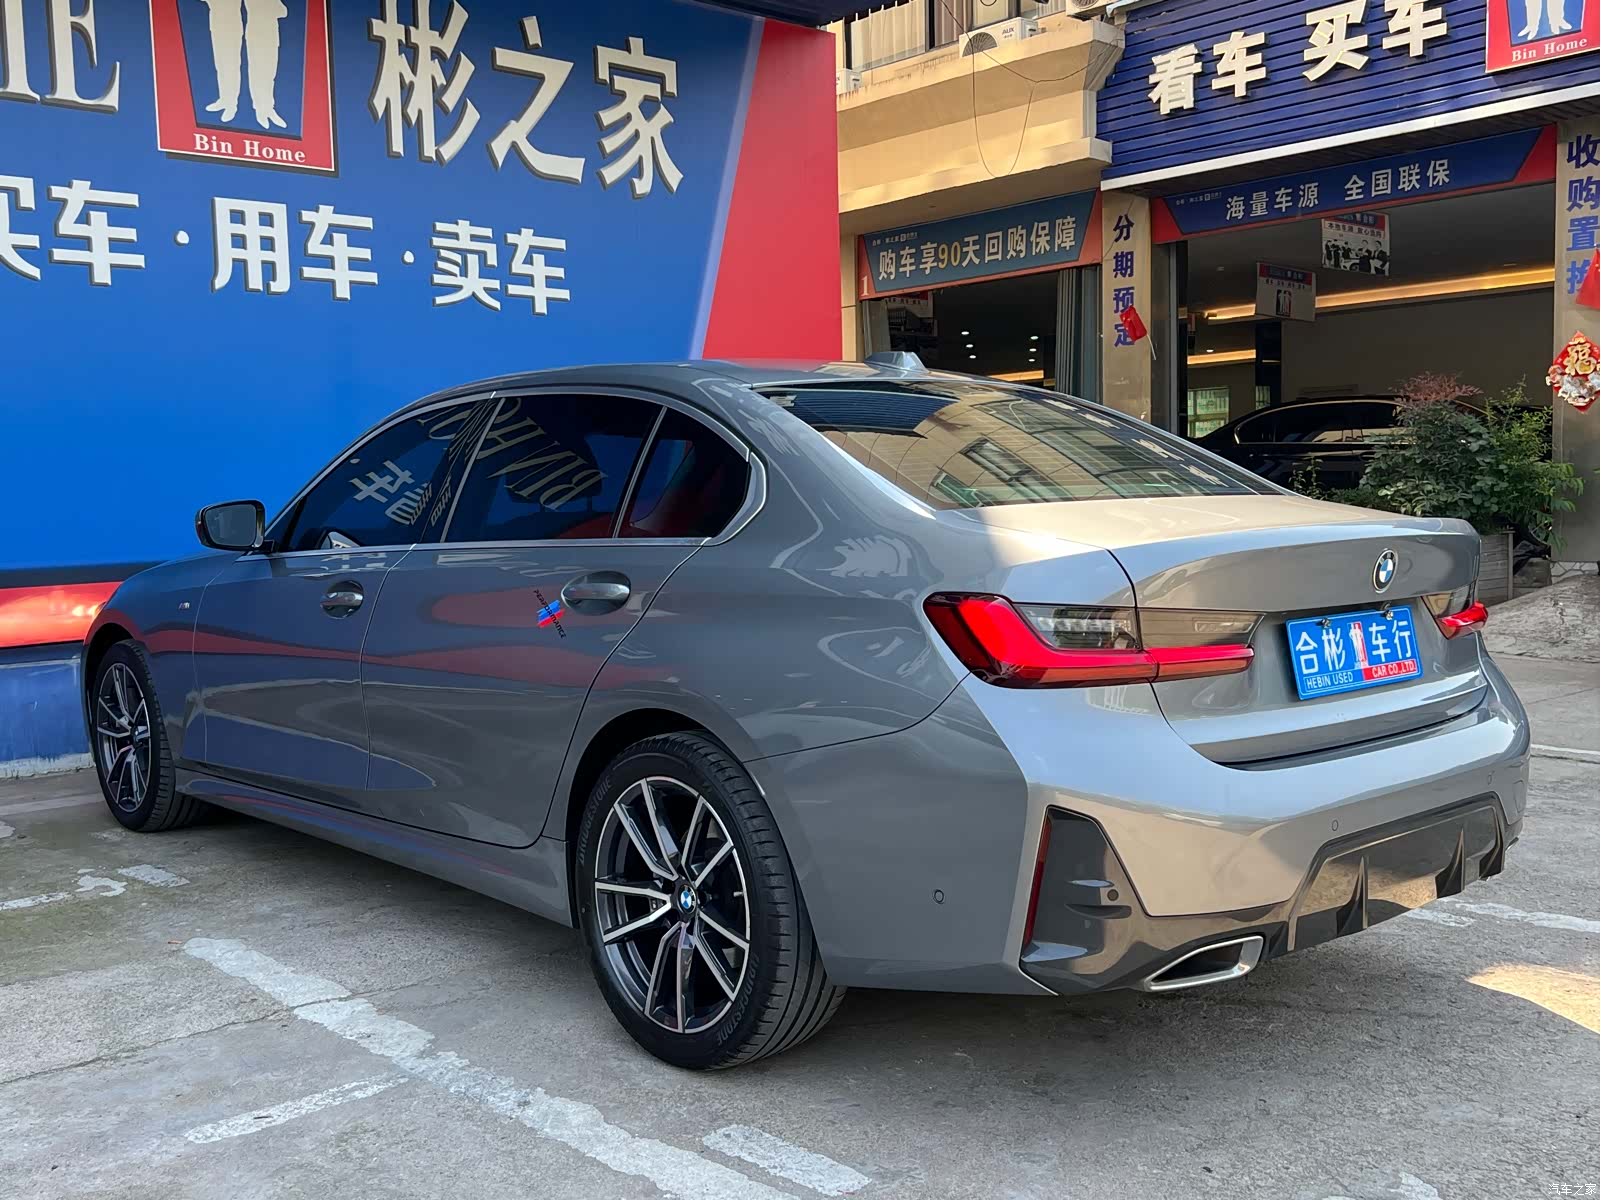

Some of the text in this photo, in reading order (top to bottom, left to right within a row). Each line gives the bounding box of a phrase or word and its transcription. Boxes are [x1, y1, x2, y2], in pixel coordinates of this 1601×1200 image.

[1148, 0, 1449, 115] 看车 买车
[1511, 36, 1589, 63] Bin Home
[369, 0, 684, 196] 彬之家
[193, 132, 307, 165] Bin Home
[1344, 159, 1451, 202] 全国联保
[1225, 182, 1320, 222] 海量车源
[878, 215, 1077, 281] 购车享90天回购保障
[861, 275, 870, 297] 1
[1112, 214, 1136, 348] 分期预定
[1563, 343, 1597, 376] 福
[1296, 619, 1412, 675] 合彬 车行
[1307, 674, 1331, 689] HEBIN
[1333, 672, 1354, 685] USED
[1372, 665, 1388, 678] CAR
